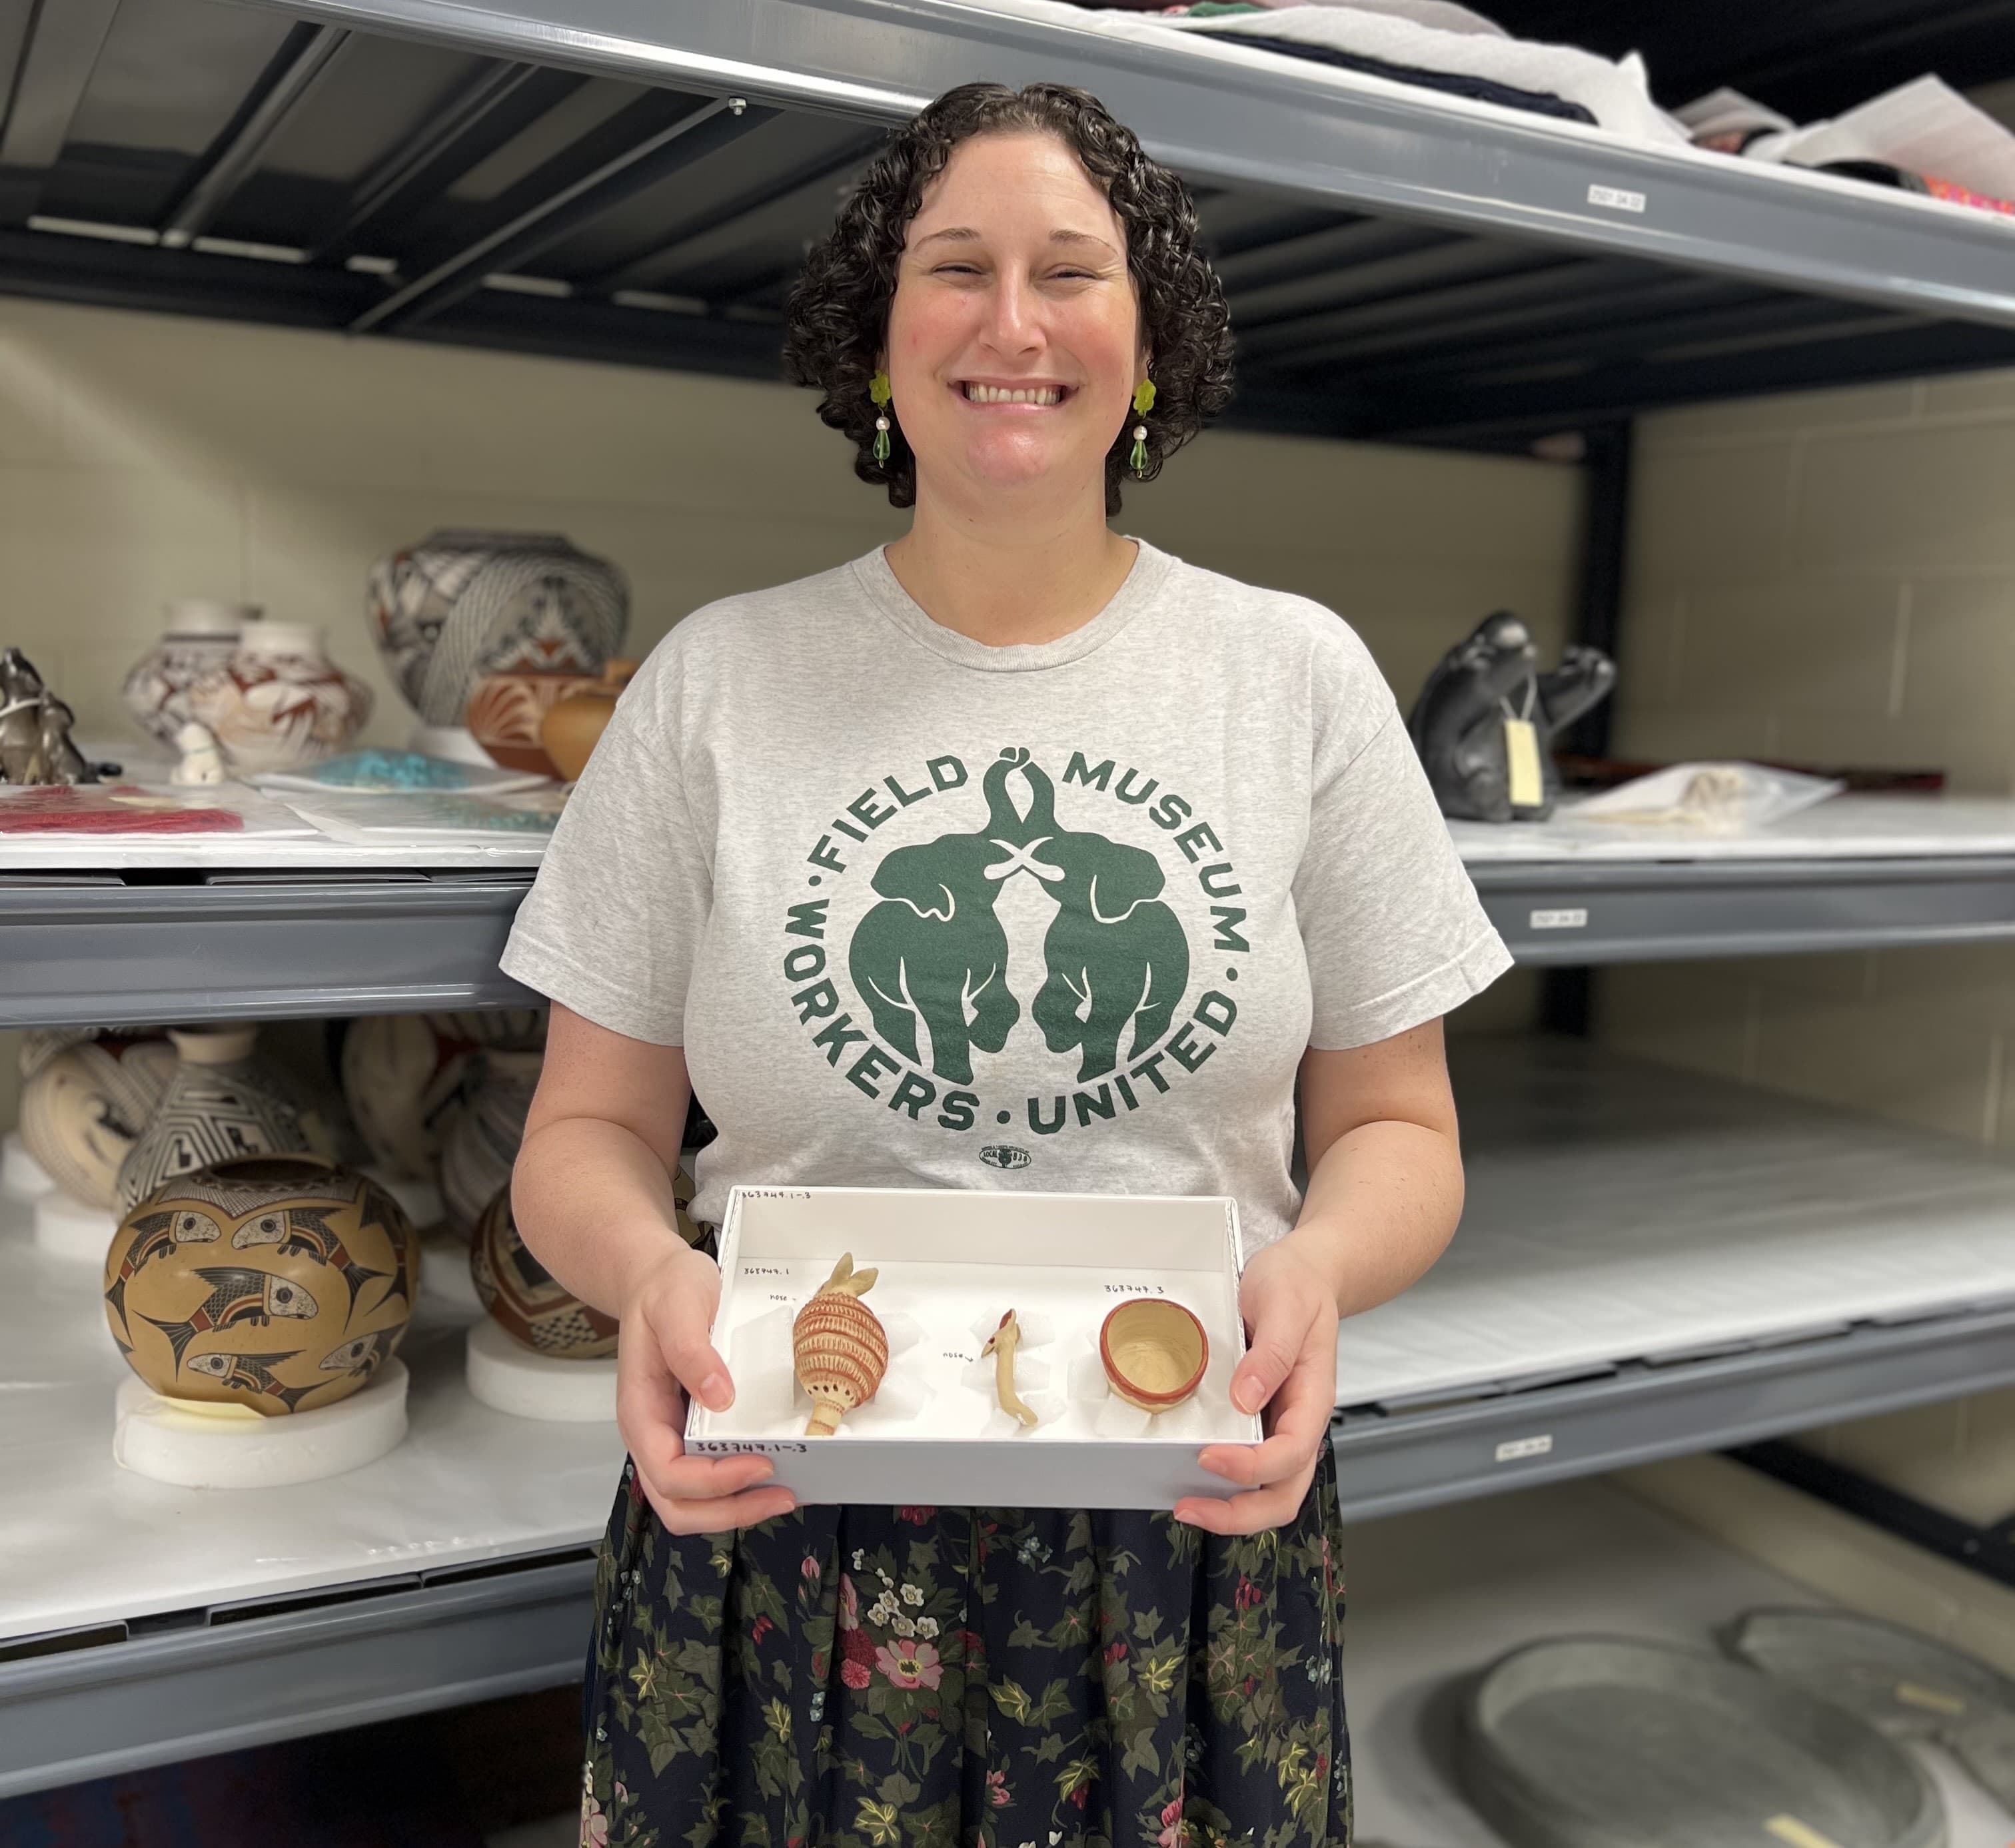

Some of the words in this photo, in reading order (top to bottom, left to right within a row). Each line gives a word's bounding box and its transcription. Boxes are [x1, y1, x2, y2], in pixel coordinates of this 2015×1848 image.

[807, 755, 969, 873] FIELD
[1062, 751, 1251, 952] MUSEUM
[784, 899, 980, 1131] WORKERS
[1027, 990, 1237, 1135] UNITED
